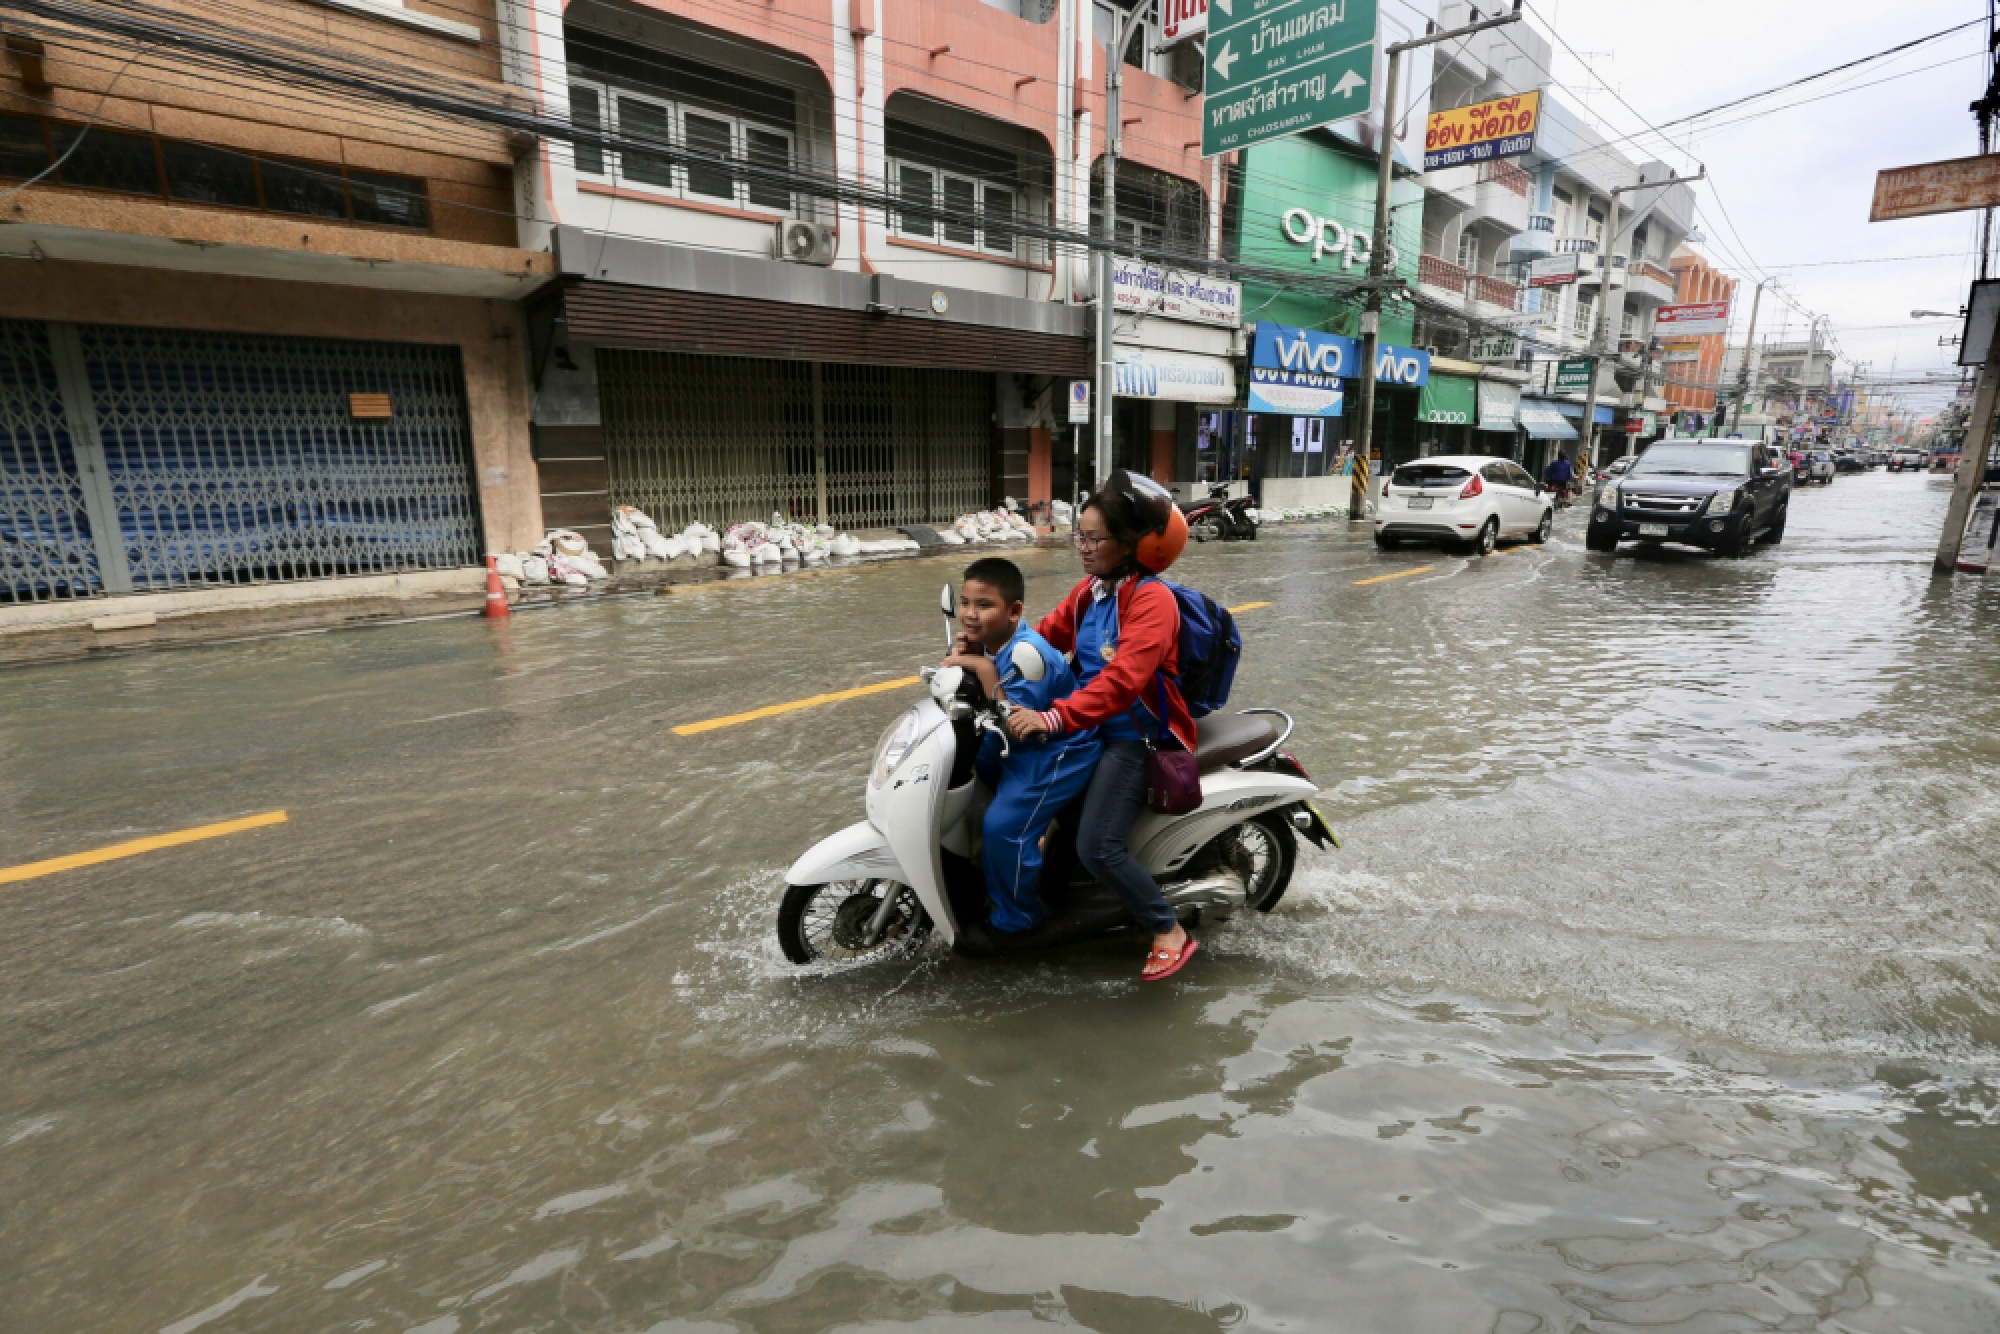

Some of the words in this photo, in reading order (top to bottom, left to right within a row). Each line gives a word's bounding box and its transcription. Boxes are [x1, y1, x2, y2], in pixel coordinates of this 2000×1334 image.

[1251, 0, 1344, 55] บ้านแหลม
[1212, 74, 1327, 127] หาดเจ้าสำราญ
